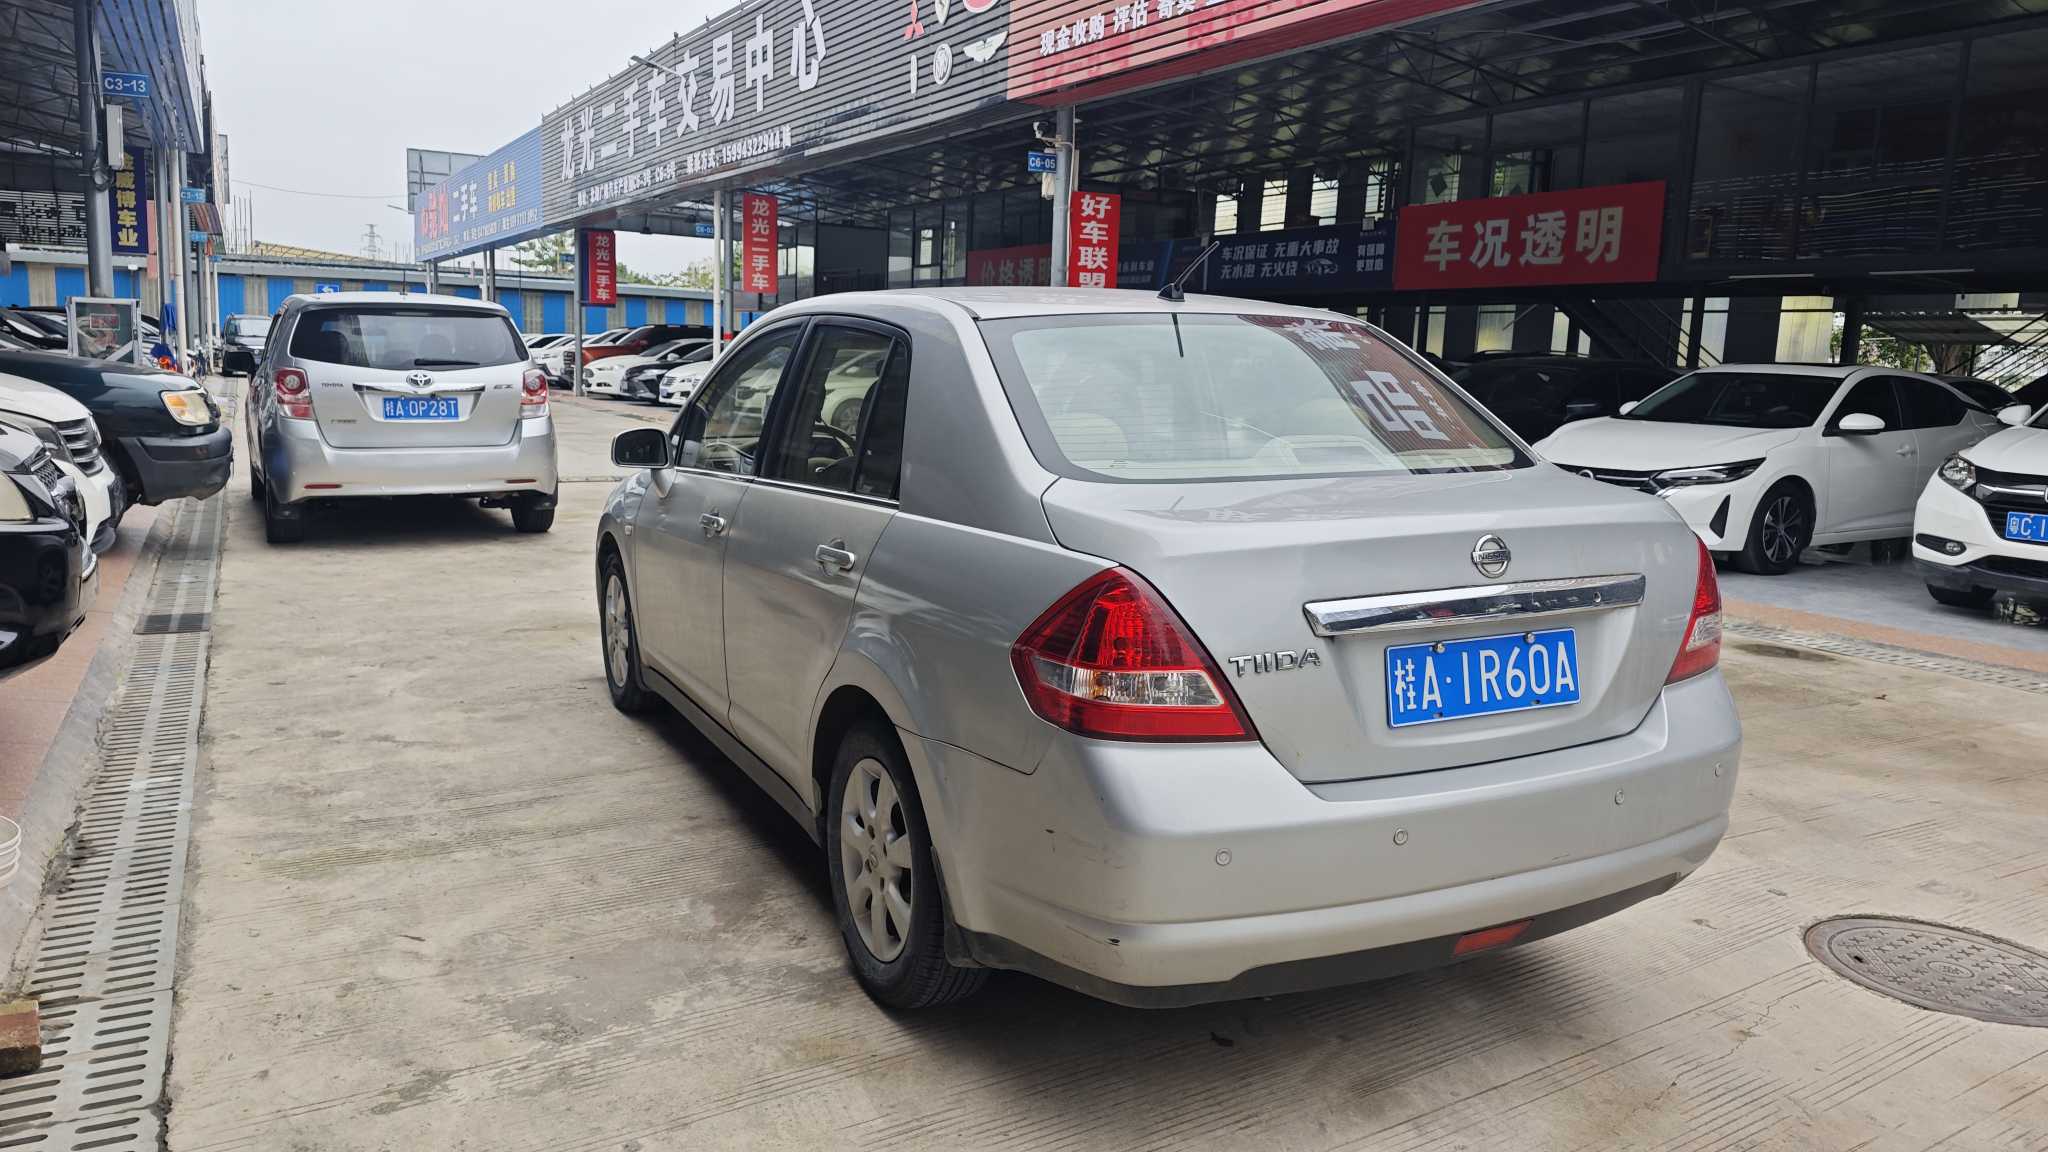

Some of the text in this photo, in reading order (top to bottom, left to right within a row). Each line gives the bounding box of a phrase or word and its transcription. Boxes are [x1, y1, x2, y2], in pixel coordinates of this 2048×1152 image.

[1039, 13, 1105, 57] 现金收购
[1112, 0, 1149, 33] 评估
[103, 76, 147, 93] C3-13
[1029, 155, 1056, 170] C6-05
[751, 198, 770, 291] 龙光二手车
[1221, 243, 1269, 260] 车况保证
[1423, 206, 1625, 272] 车况透明
[596, 236, 611, 302] 龙光二手车
[1228, 647, 1321, 678] TIIDA
